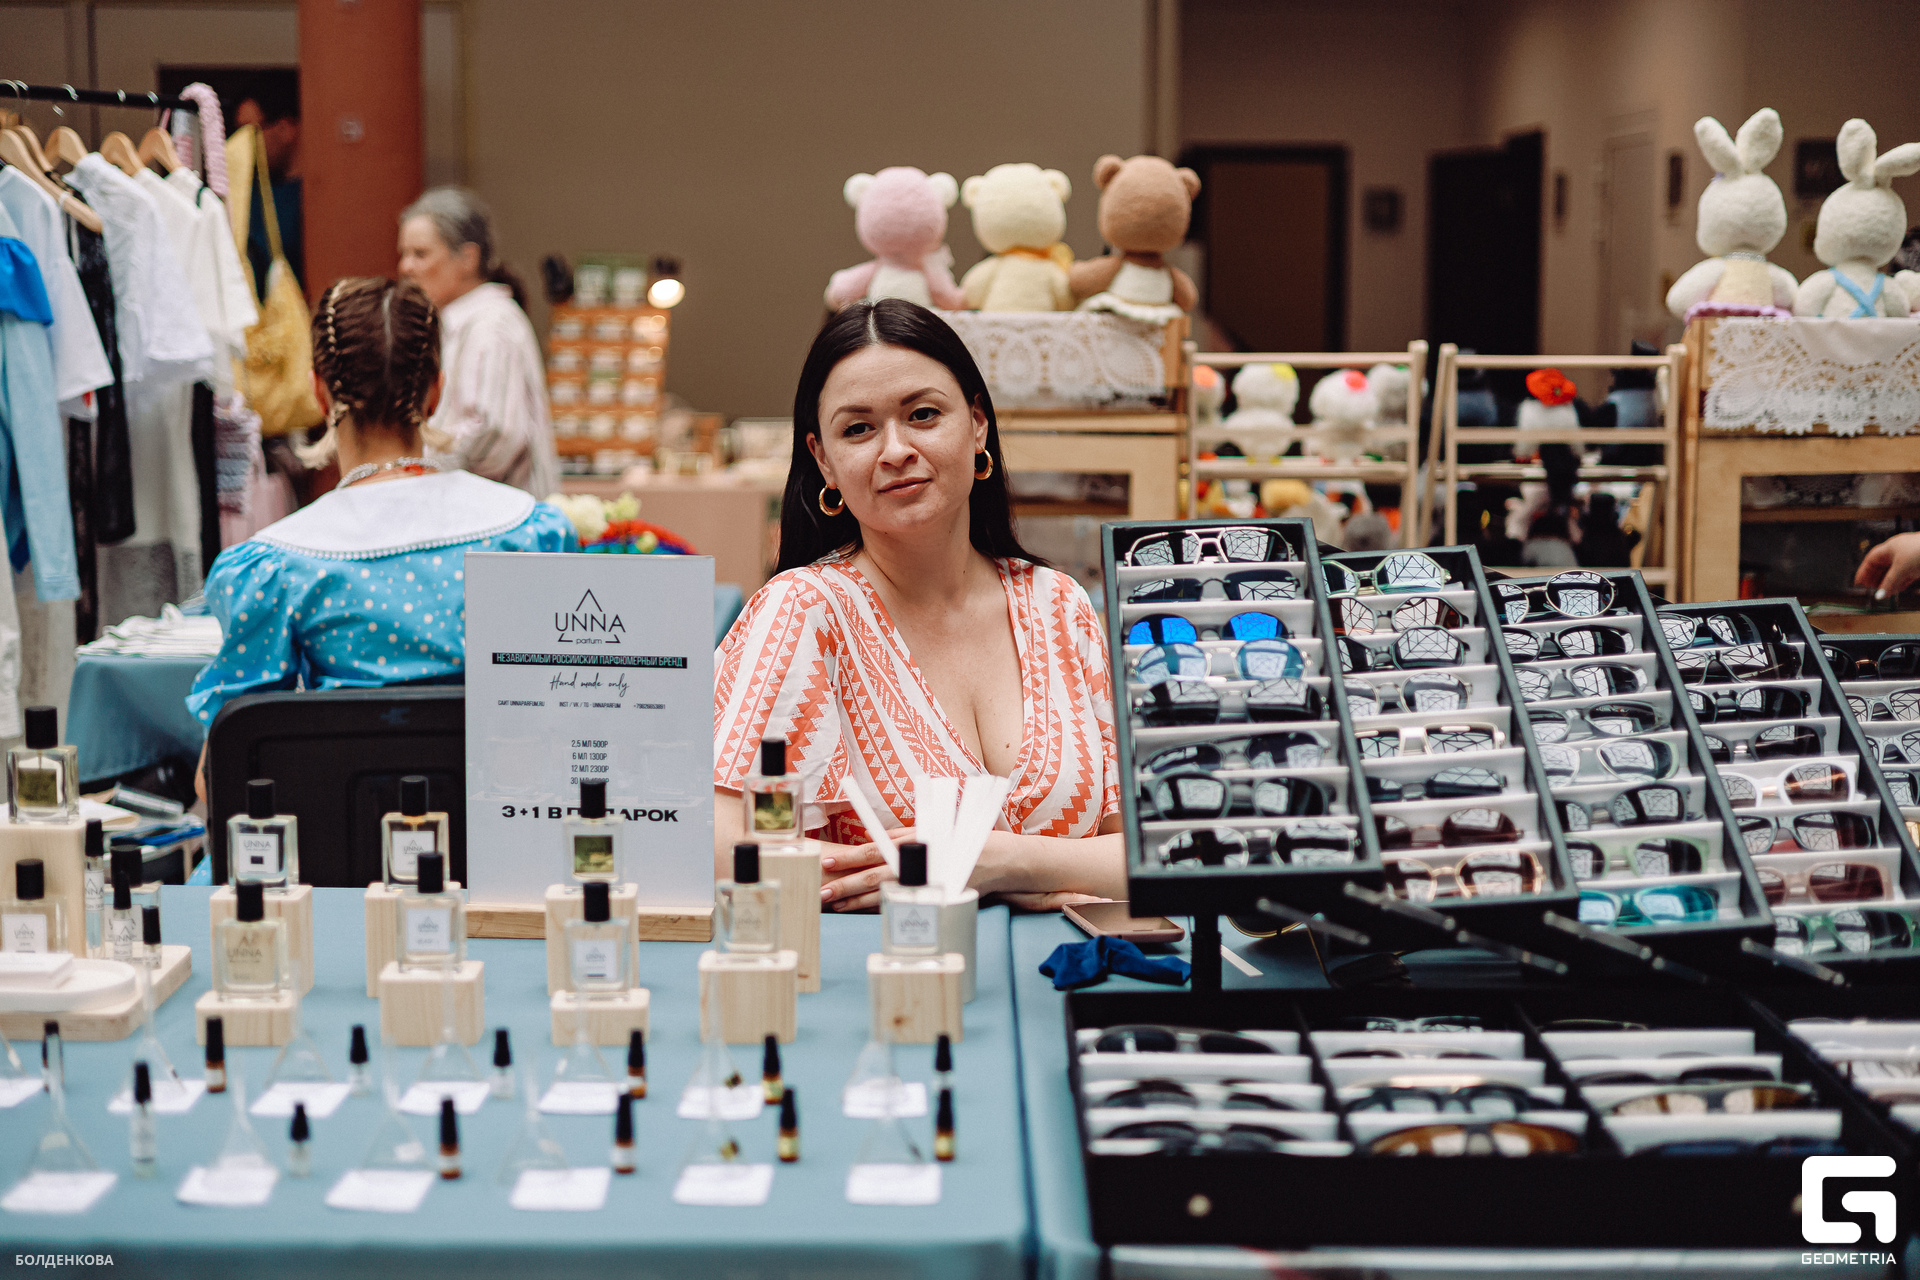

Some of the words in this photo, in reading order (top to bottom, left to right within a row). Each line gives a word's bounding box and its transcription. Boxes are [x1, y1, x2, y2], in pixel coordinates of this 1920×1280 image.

[555, 612, 626, 633] UNNA
[658, 657, 684, 668] БРЕНД
[549, 672, 578, 691] Hand
[580, 672, 604, 689] made
[608, 673, 630, 698] only
[582, 740, 592, 748] МЛ
[572, 752, 577, 760] 6
[578, 752, 588, 760] МЛ
[571, 764, 578, 773] 12
[579, 765, 589, 773] МЛ
[570, 776, 579, 785] 30
[548, 807, 562, 819] В
